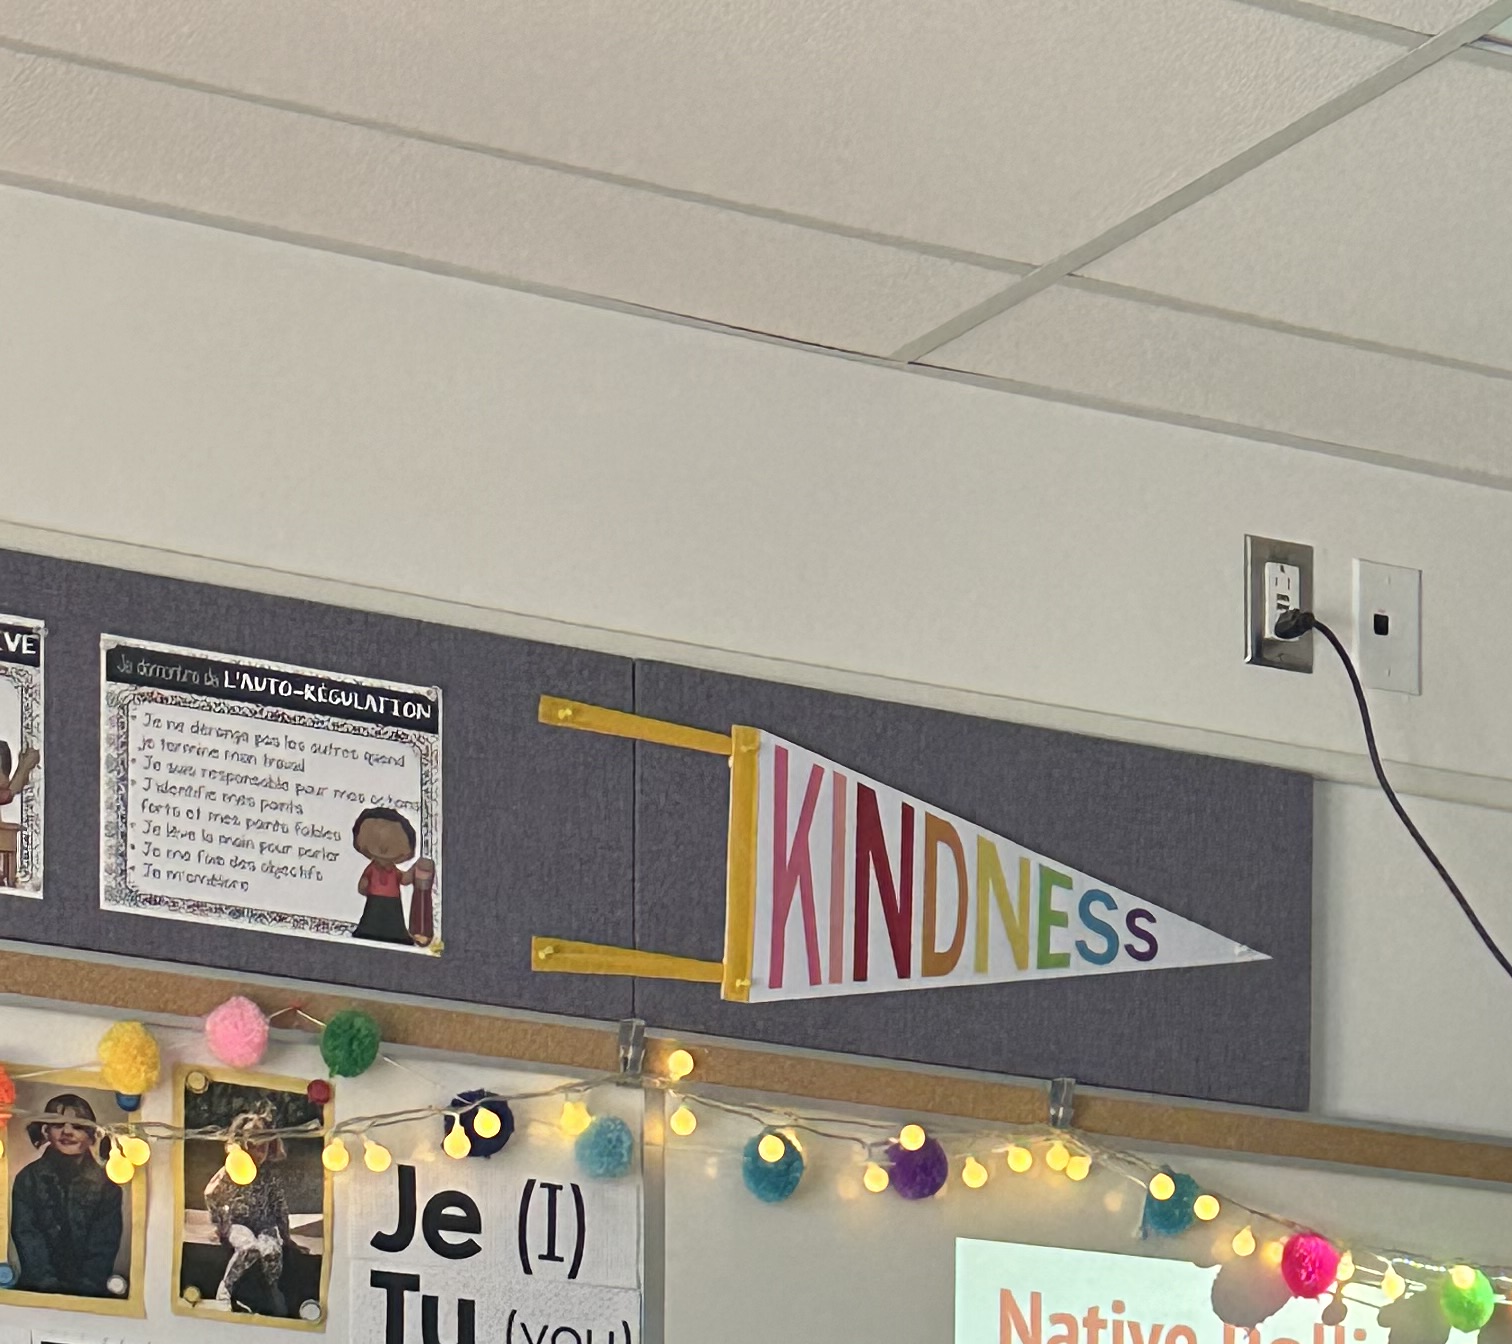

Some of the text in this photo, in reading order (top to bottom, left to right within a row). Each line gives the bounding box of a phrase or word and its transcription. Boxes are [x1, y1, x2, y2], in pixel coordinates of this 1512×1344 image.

[0, 631, 38, 654] VE
[224, 670, 431, 719] L'AUTO-RÉGULATION
[769, 745, 1159, 990] KINDNESS
[370, 1165, 586, 1279] Je (I)
